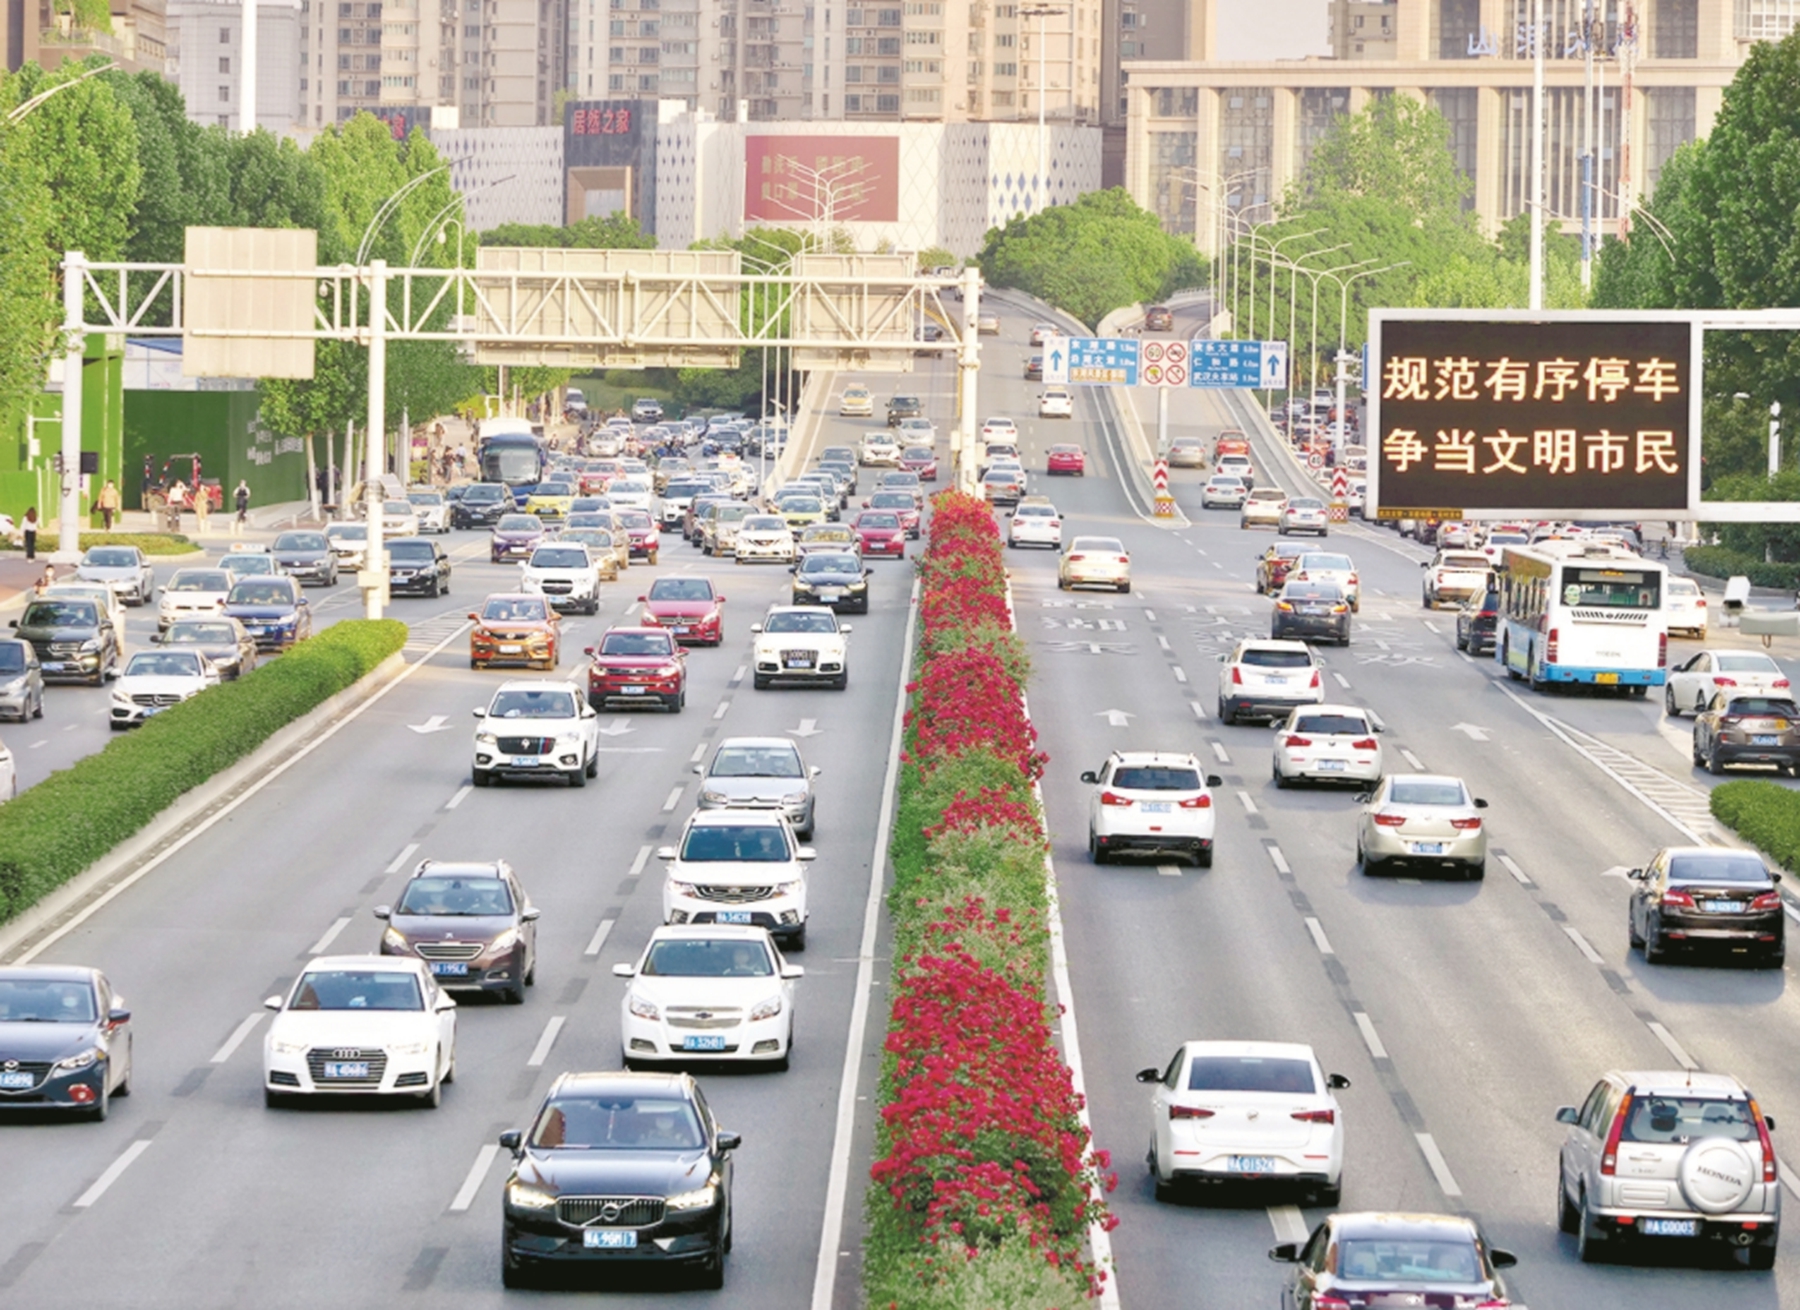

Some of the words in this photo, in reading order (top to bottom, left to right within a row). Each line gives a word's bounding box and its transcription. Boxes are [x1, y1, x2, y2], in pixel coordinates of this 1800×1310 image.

[574, 108, 630, 134] 居然之家
[1382, 356, 1680, 402] 规范有序停车
[1382, 427, 1680, 474] 争当文明市民
[1697, 1165, 1742, 1187] HONDA
